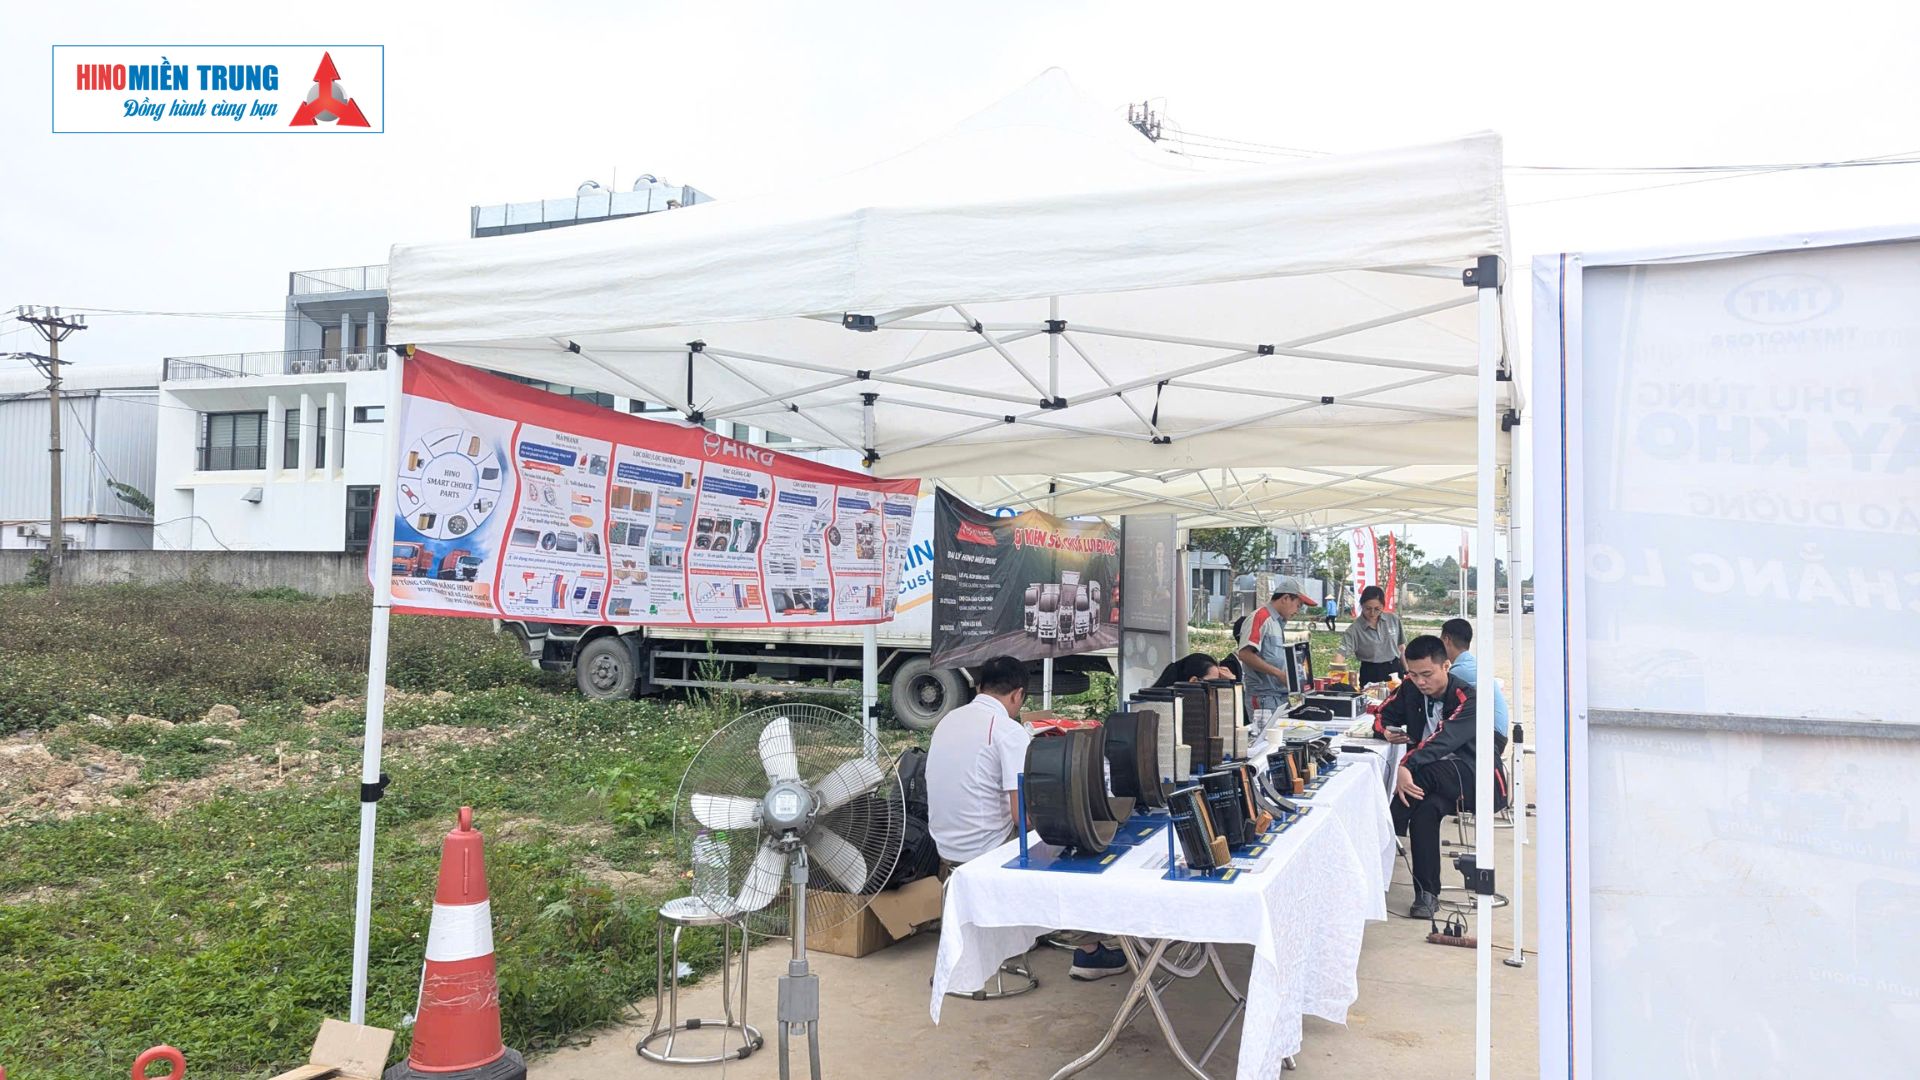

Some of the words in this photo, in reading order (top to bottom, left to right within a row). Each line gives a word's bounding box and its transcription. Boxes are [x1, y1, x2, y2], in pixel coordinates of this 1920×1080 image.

[722, 441, 776, 467] HINO
[443, 469, 460, 478] HINO
[426, 477, 449, 488] SMART
[450, 479, 474, 491] CHOICE
[439, 490, 461, 499] PARTS
